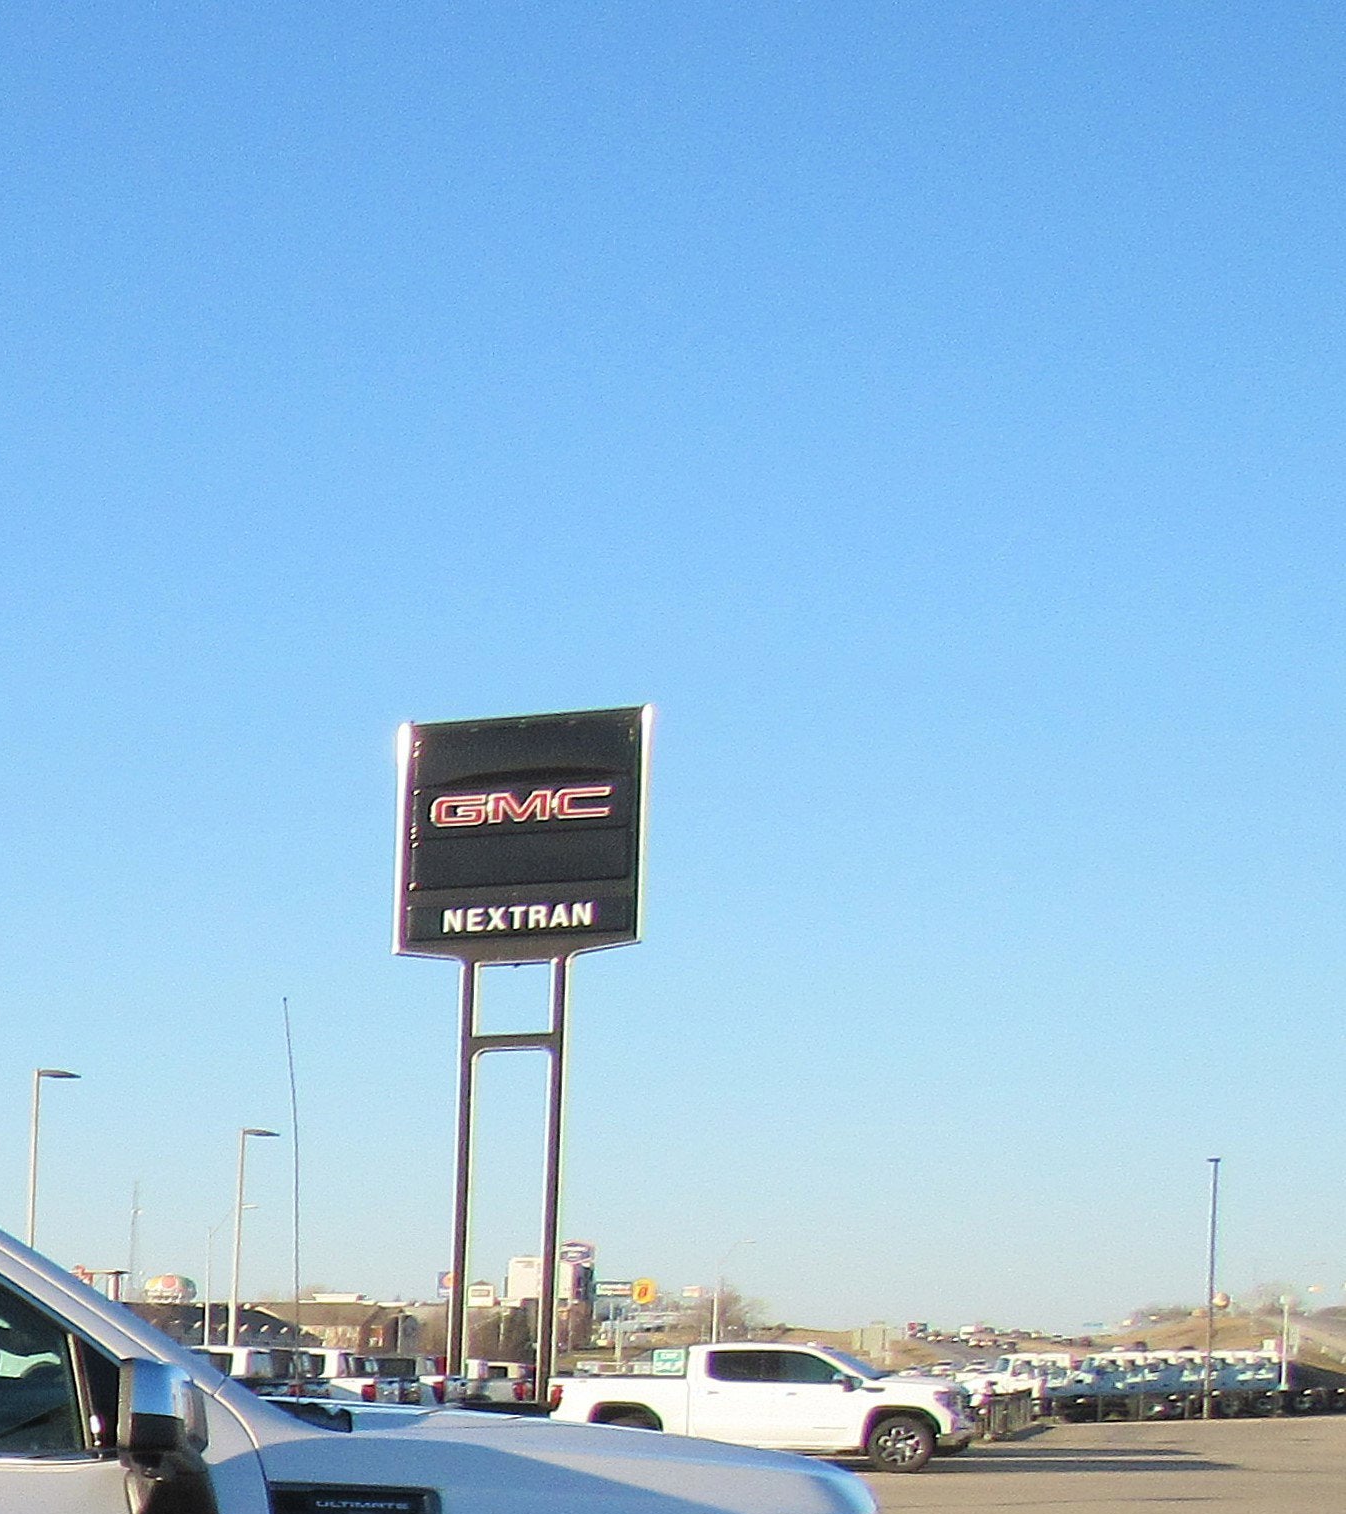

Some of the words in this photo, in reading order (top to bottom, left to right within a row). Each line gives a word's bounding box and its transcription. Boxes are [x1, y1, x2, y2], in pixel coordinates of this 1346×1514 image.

[430, 786, 615, 828] GMC
[441, 902, 594, 933] NEXTRAN
[315, 1500, 410, 1510] ULTIMATE
